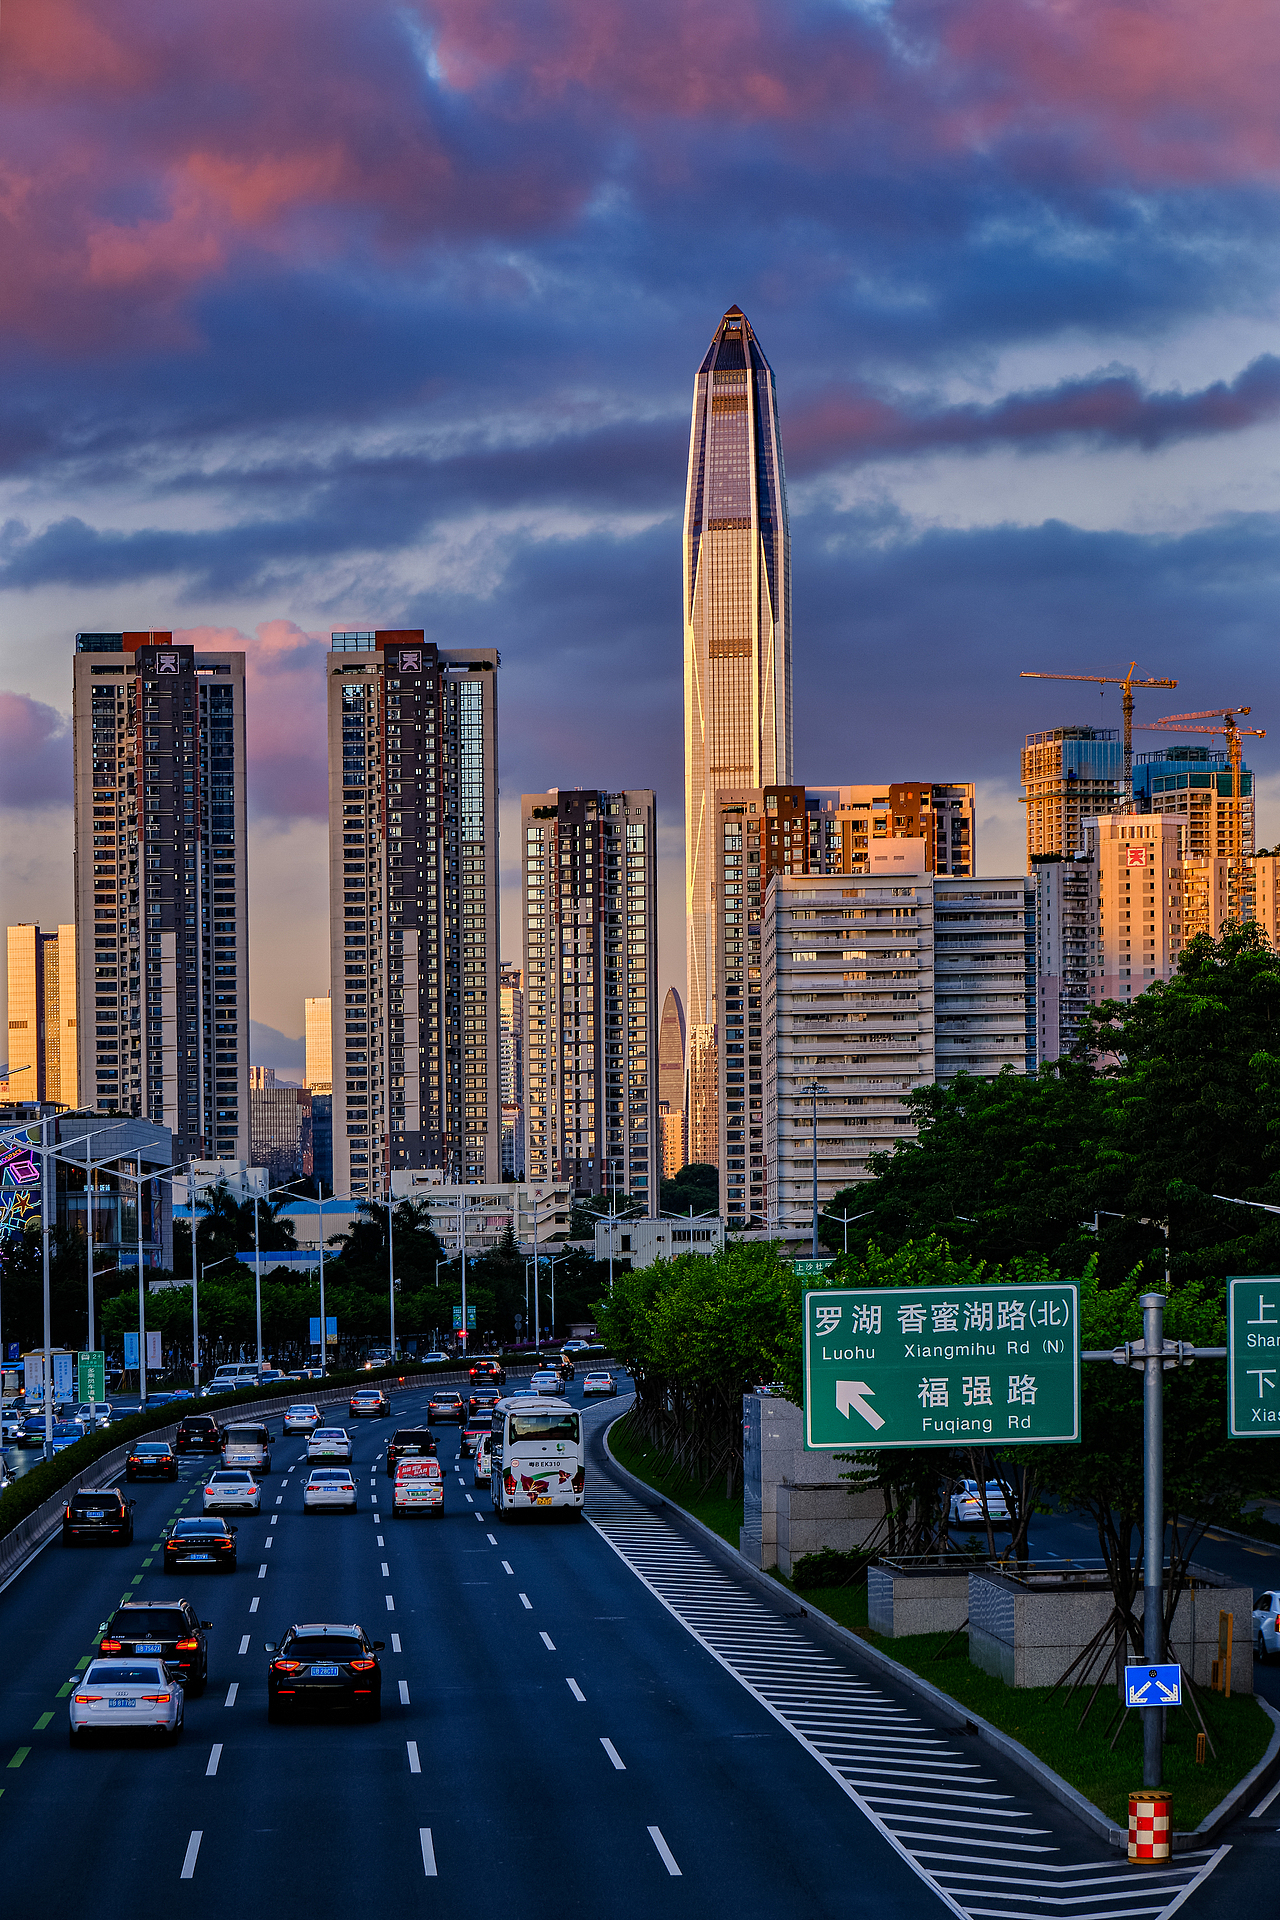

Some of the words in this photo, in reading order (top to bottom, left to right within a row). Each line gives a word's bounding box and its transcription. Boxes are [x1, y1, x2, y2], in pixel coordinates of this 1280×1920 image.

[814, 1304, 882, 1336] 罗湖
[1247, 1295, 1278, 1325] 上
[822, 1346, 876, 1361] Luohu
[904, 1342, 996, 1359] Xiangmihu
[1007, 1340, 1030, 1355] Rd
[1043, 1339, 1065, 1354] (N)
[918, 1374, 1039, 1408] 福强路
[1247, 1369, 1277, 1398] 下
[922, 1416, 993, 1433] Fuqiang
[1008, 1415, 1031, 1429] Rd
